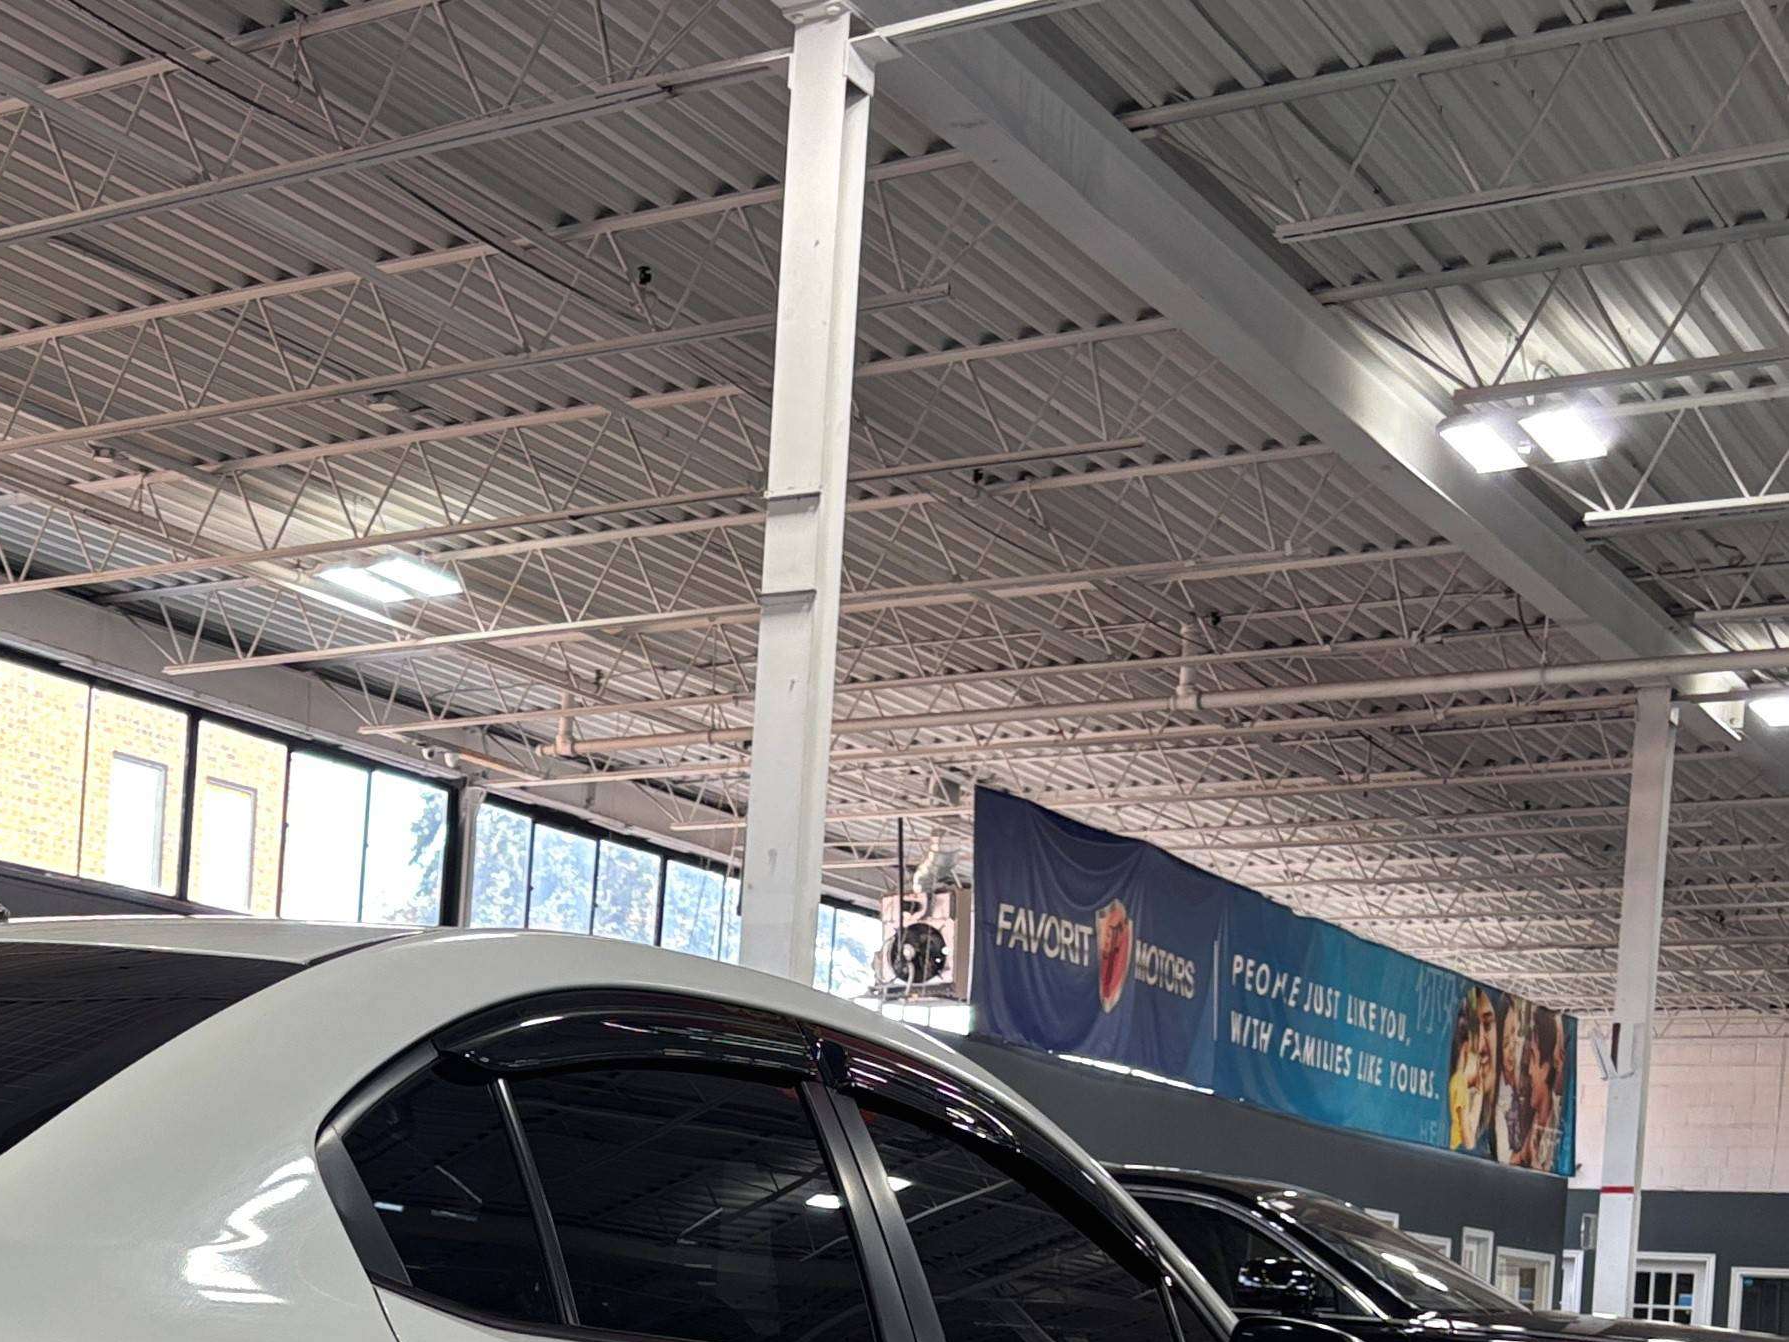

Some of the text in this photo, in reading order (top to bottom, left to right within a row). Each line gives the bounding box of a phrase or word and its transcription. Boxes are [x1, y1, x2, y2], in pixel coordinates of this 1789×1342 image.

[996, 903, 1093, 967] FAVORIT
[1134, 939, 1196, 999] MOTORS
[1230, 1010, 1439, 1100] WITH FAMILIES LIKE YOURS.
[1303, 982, 1342, 1020] JUST
[1346, 994, 1377, 1033] LIKE
[1379, 1007, 1411, 1046] YOU,
